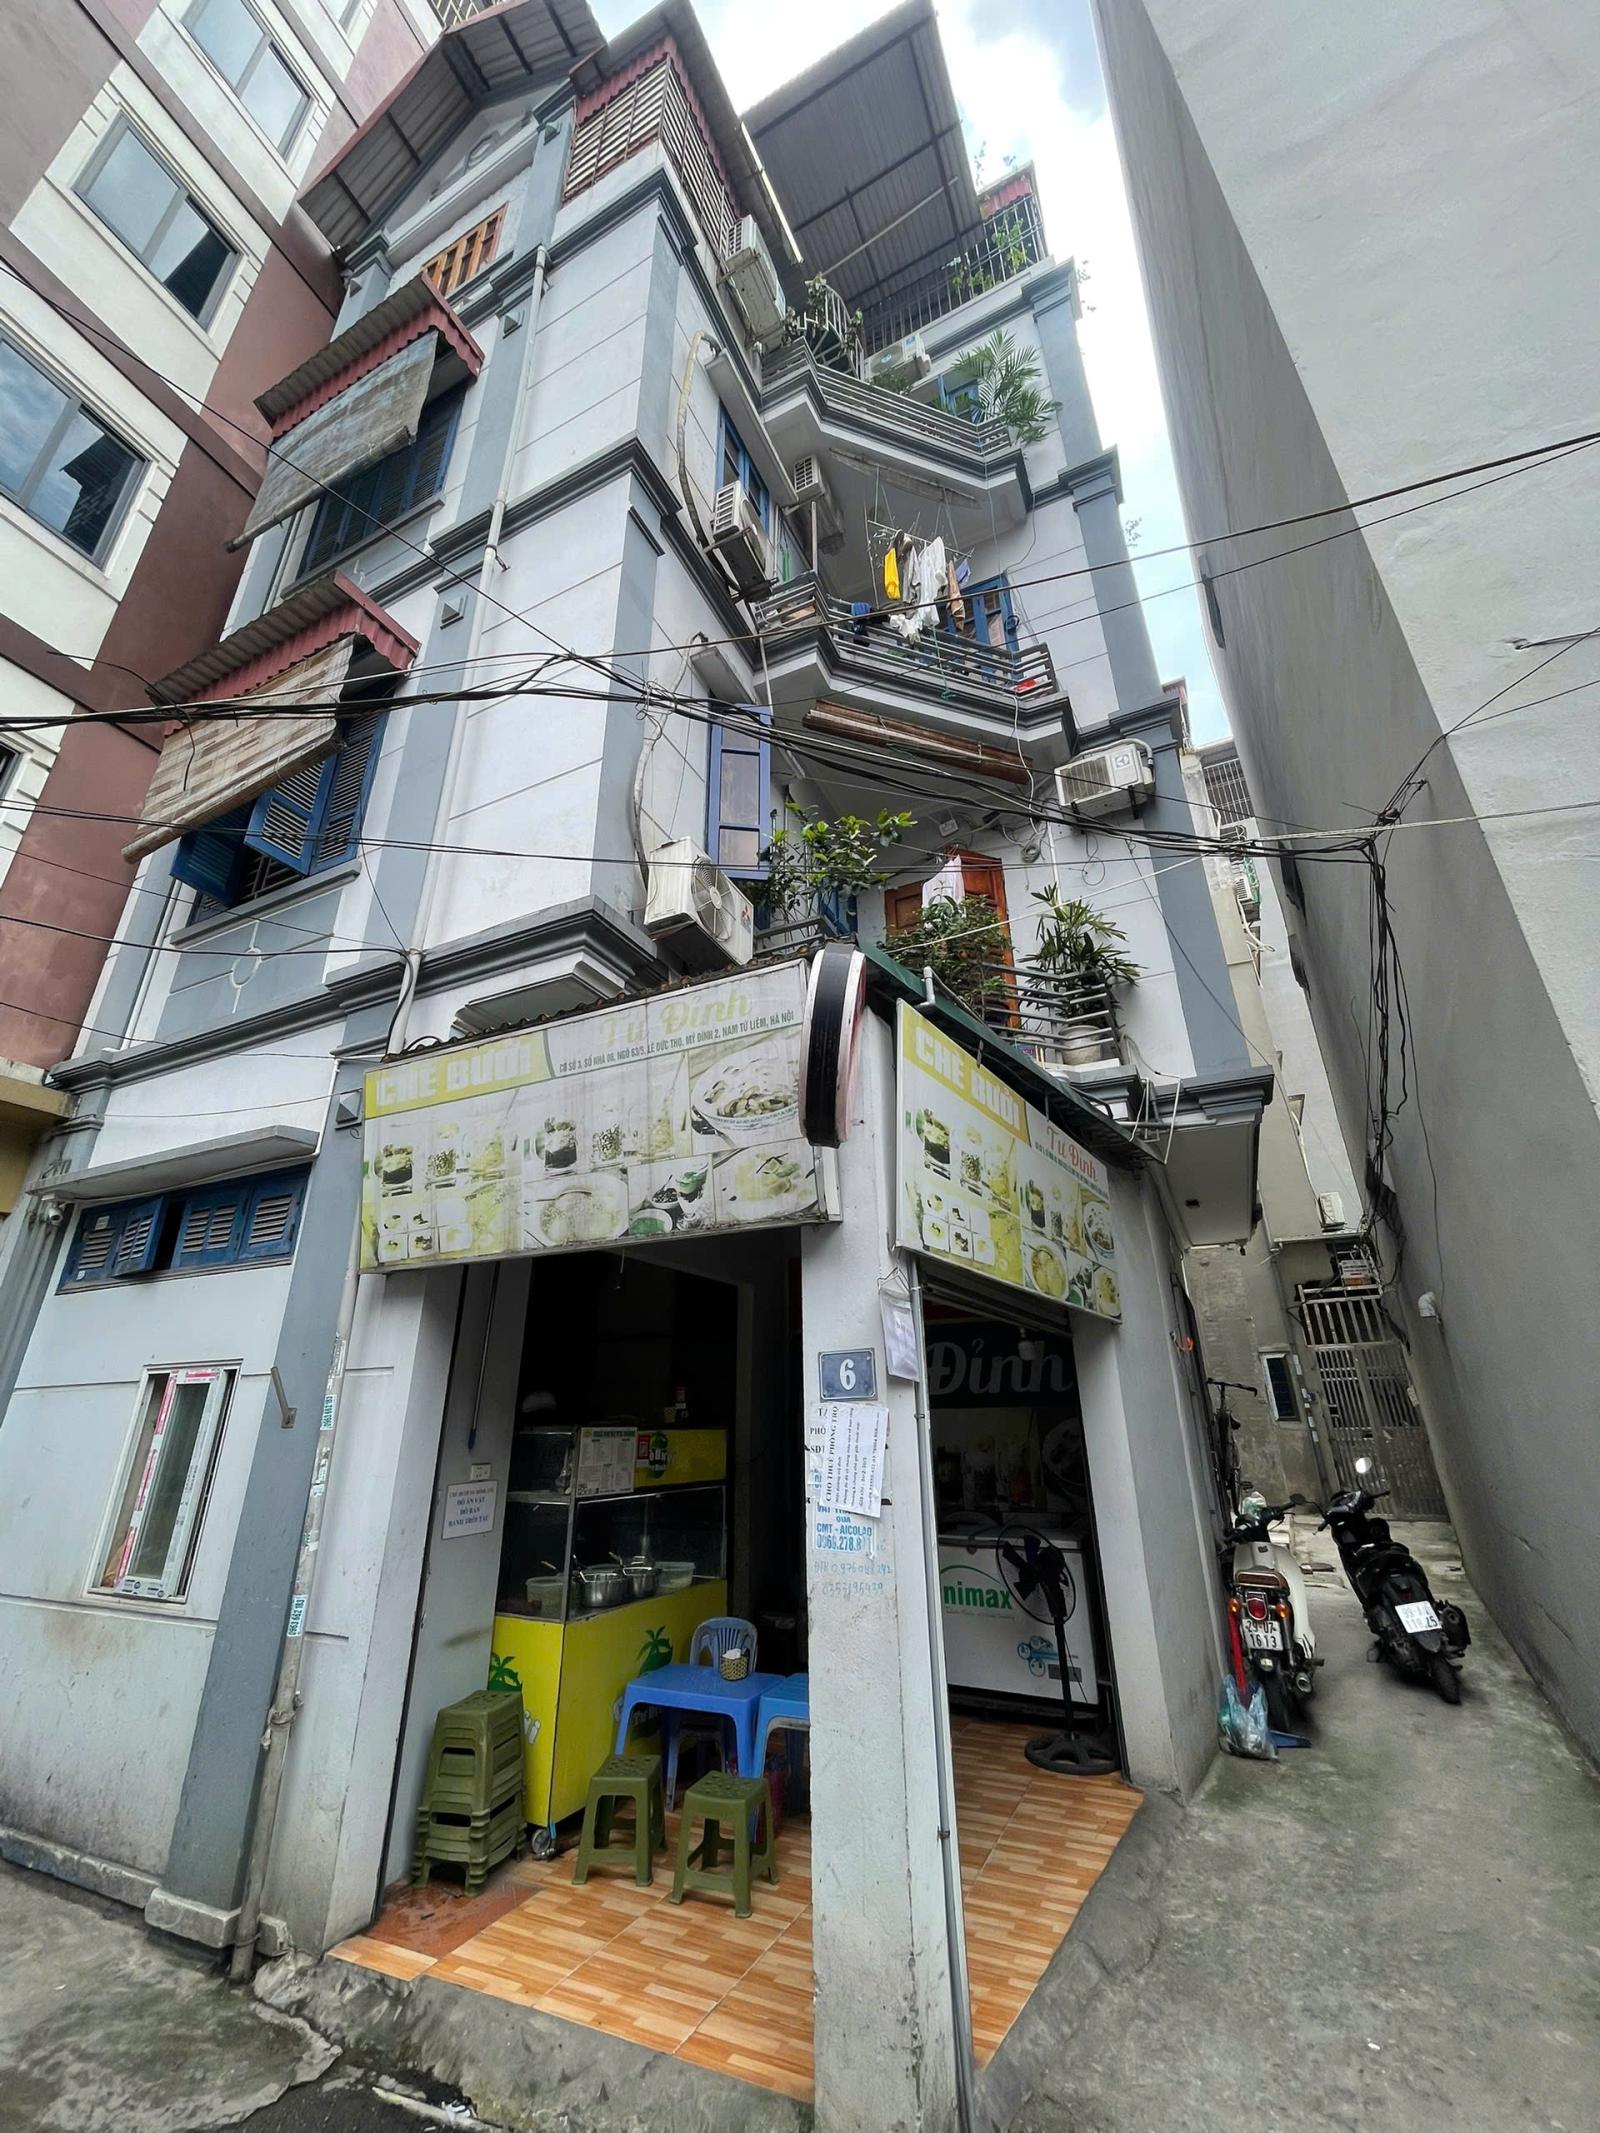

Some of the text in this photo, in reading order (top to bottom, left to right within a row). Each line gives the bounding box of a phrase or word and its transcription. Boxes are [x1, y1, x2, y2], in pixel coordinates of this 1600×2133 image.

[722, 1025, 738, 1037] NAM
[840, 1359, 856, 1390] 6
[816, 1522, 833, 1533] CMT
[1250, 1633, 1277, 1648] 1613
